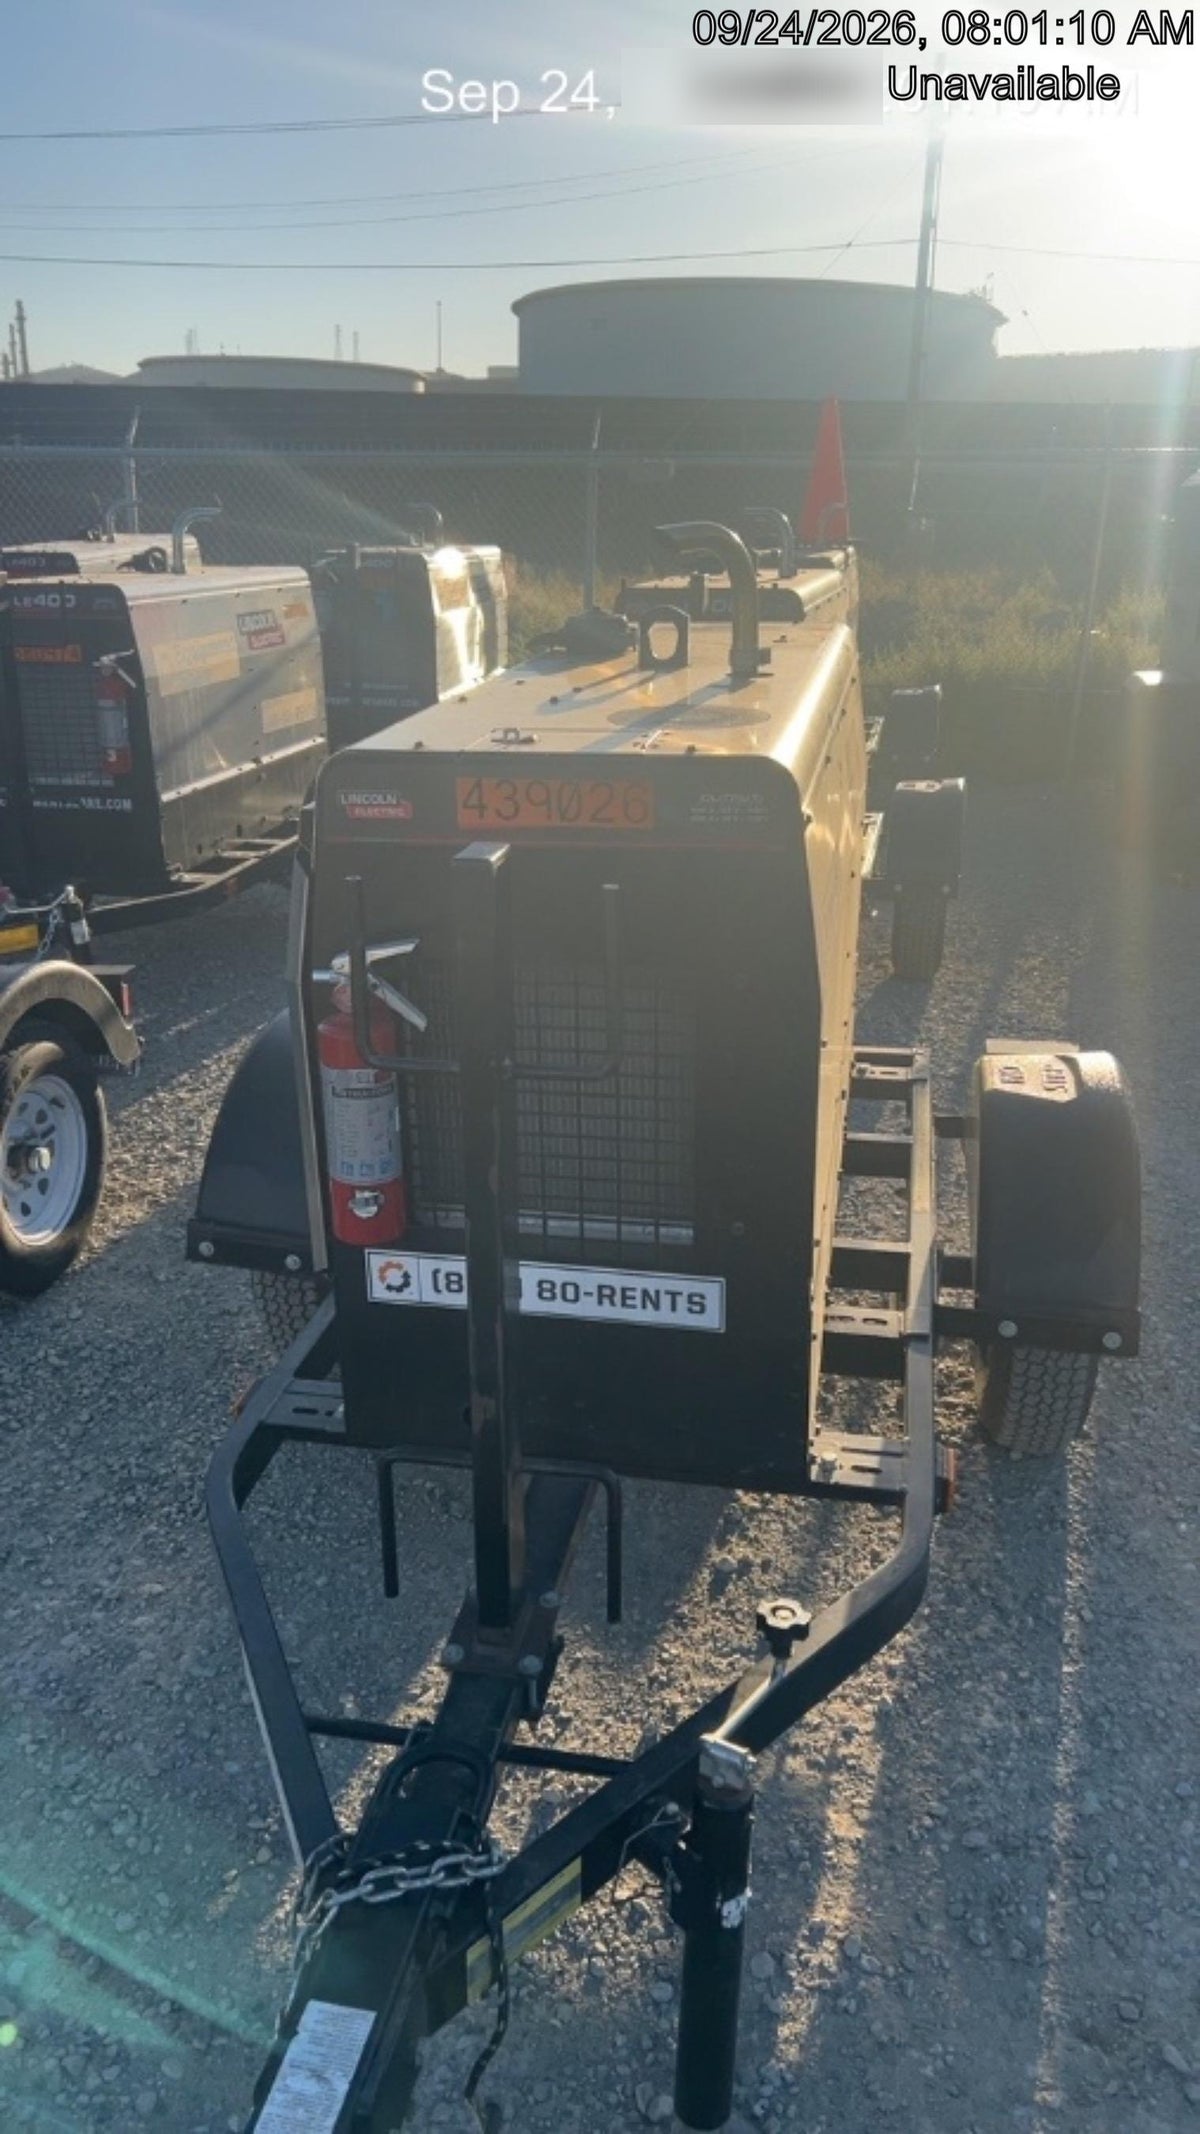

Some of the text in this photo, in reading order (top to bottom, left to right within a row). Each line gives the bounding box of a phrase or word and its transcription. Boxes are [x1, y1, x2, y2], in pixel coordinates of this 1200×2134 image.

[341, 793, 398, 805] LINCOLN
[462, 778, 650, 824] 439026
[537, 1279, 708, 1315] 80-RENTS
